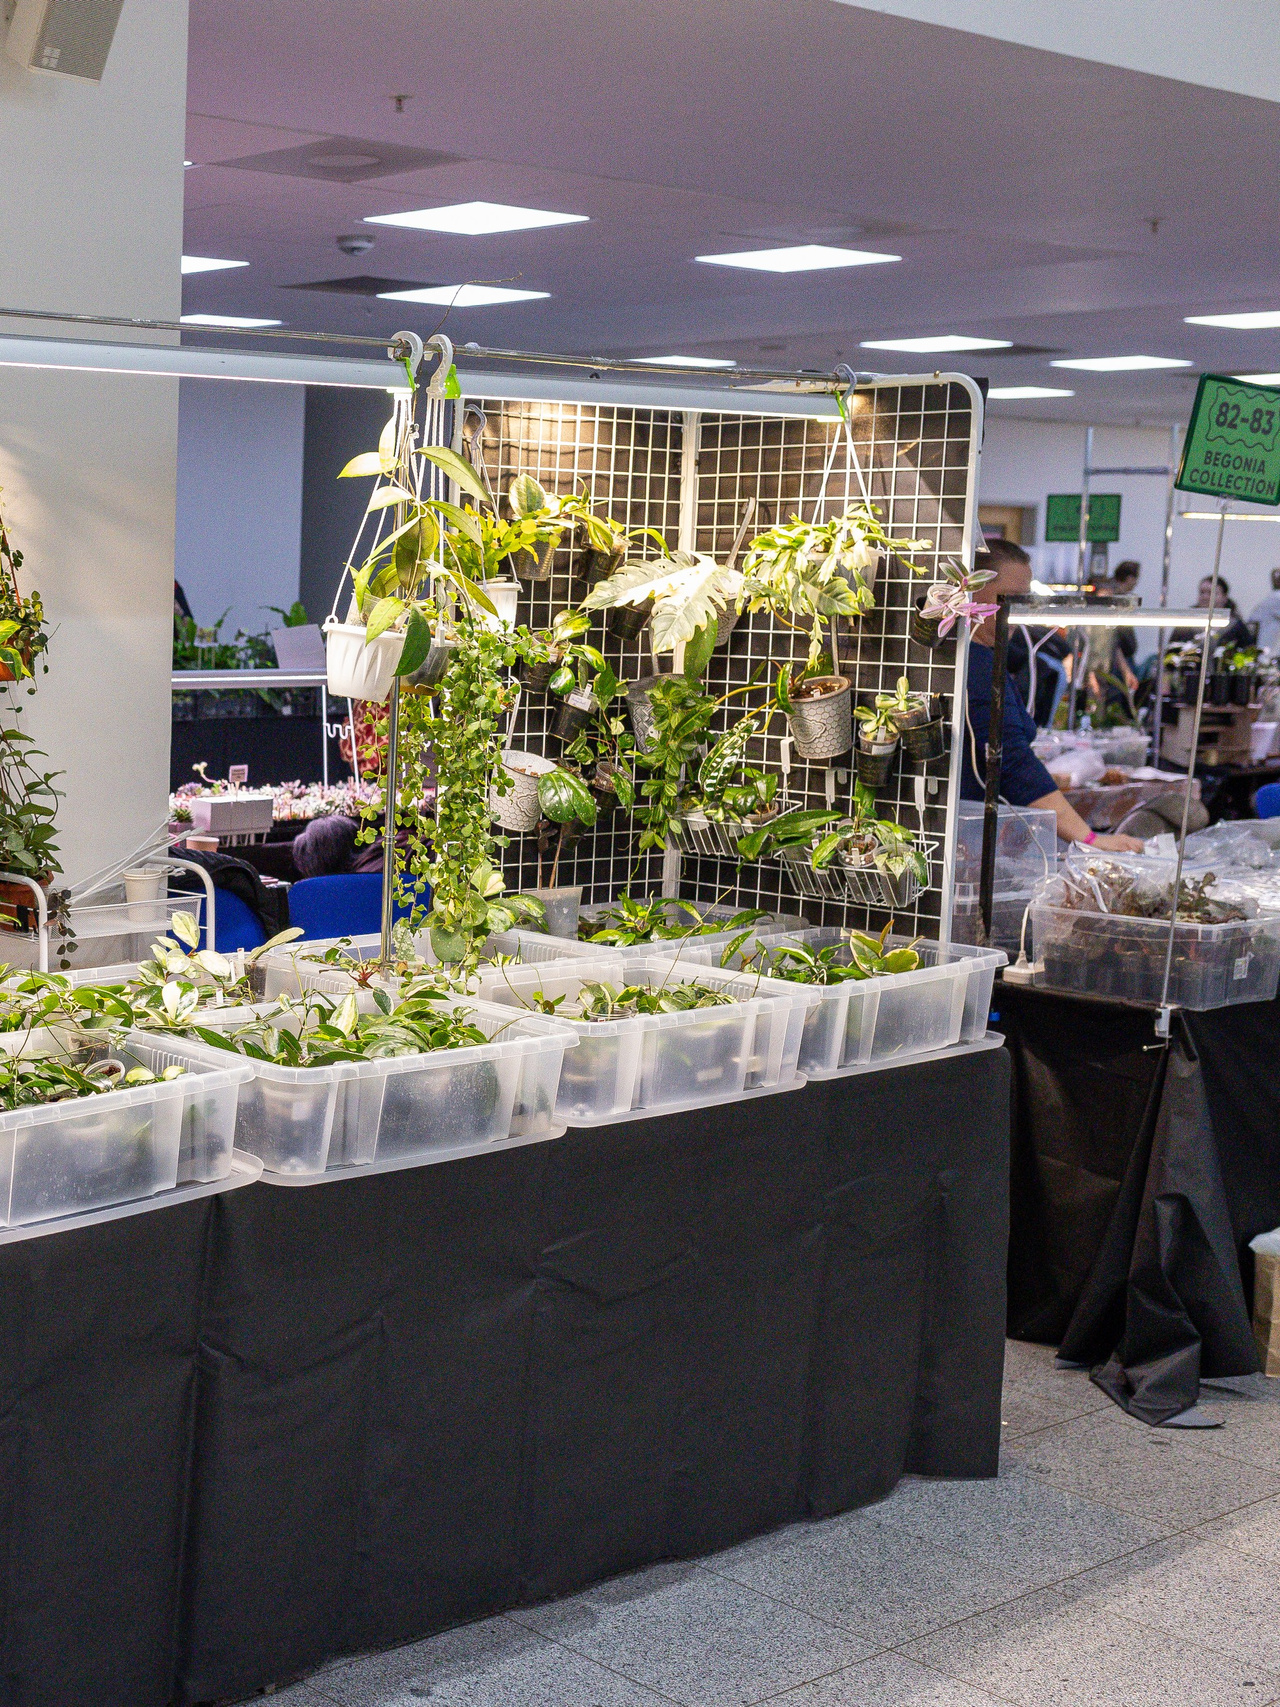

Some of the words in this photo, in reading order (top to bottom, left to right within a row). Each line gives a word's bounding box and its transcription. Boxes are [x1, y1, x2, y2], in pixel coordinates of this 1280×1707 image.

[1216, 402, 1275, 435] 82-83
[1203, 450, 1266, 475] BEGONIA
[1190, 469, 1275, 495] COLLECTION
